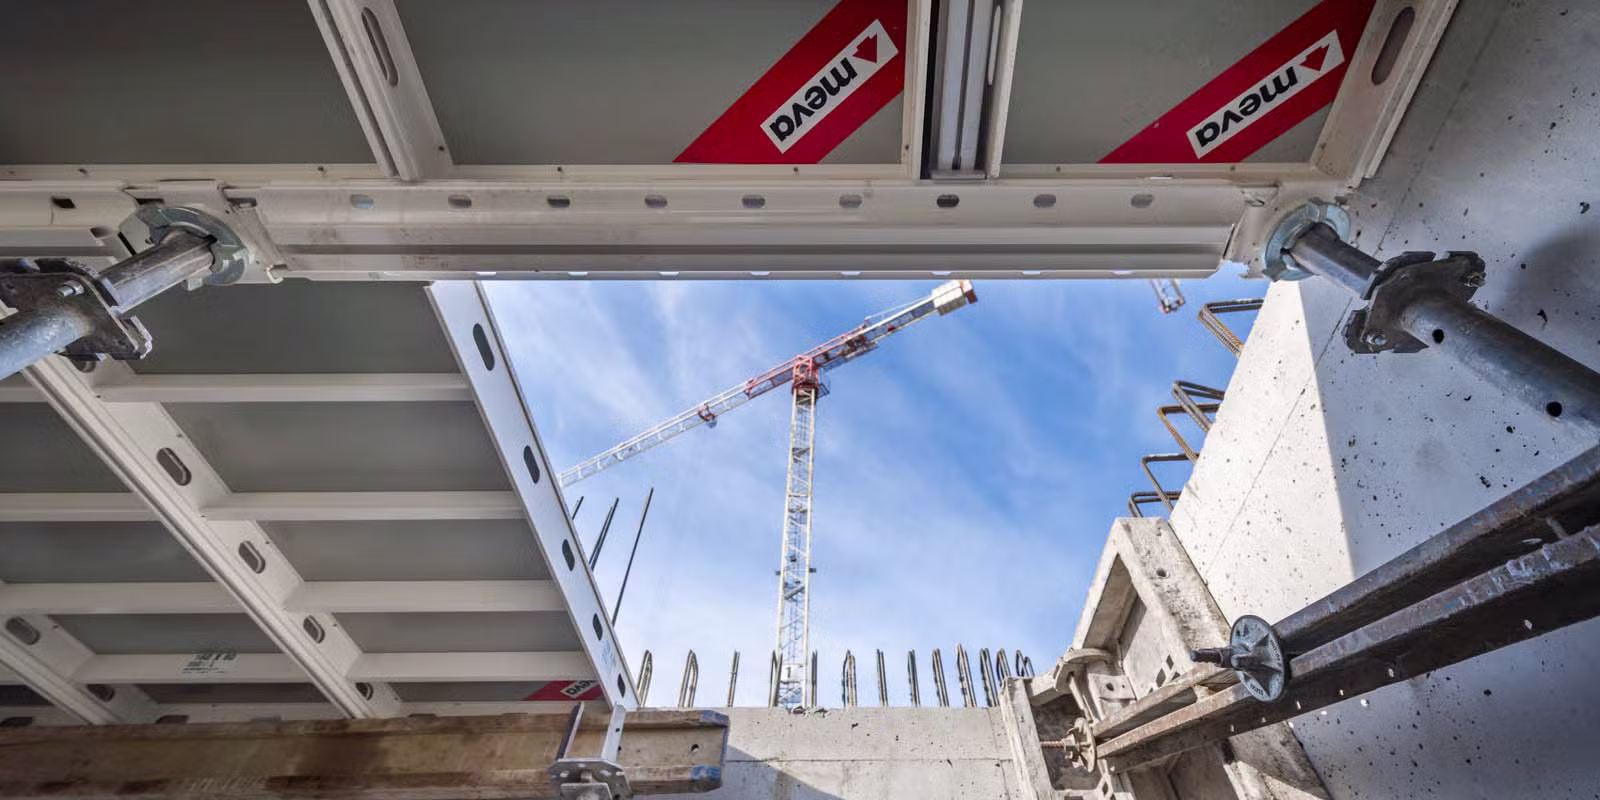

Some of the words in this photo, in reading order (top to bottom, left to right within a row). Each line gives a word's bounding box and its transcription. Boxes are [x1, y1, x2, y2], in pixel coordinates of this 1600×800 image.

[769, 57, 858, 142] meva
[1195, 66, 1298, 147] meva
[565, 680, 598, 695] eva
